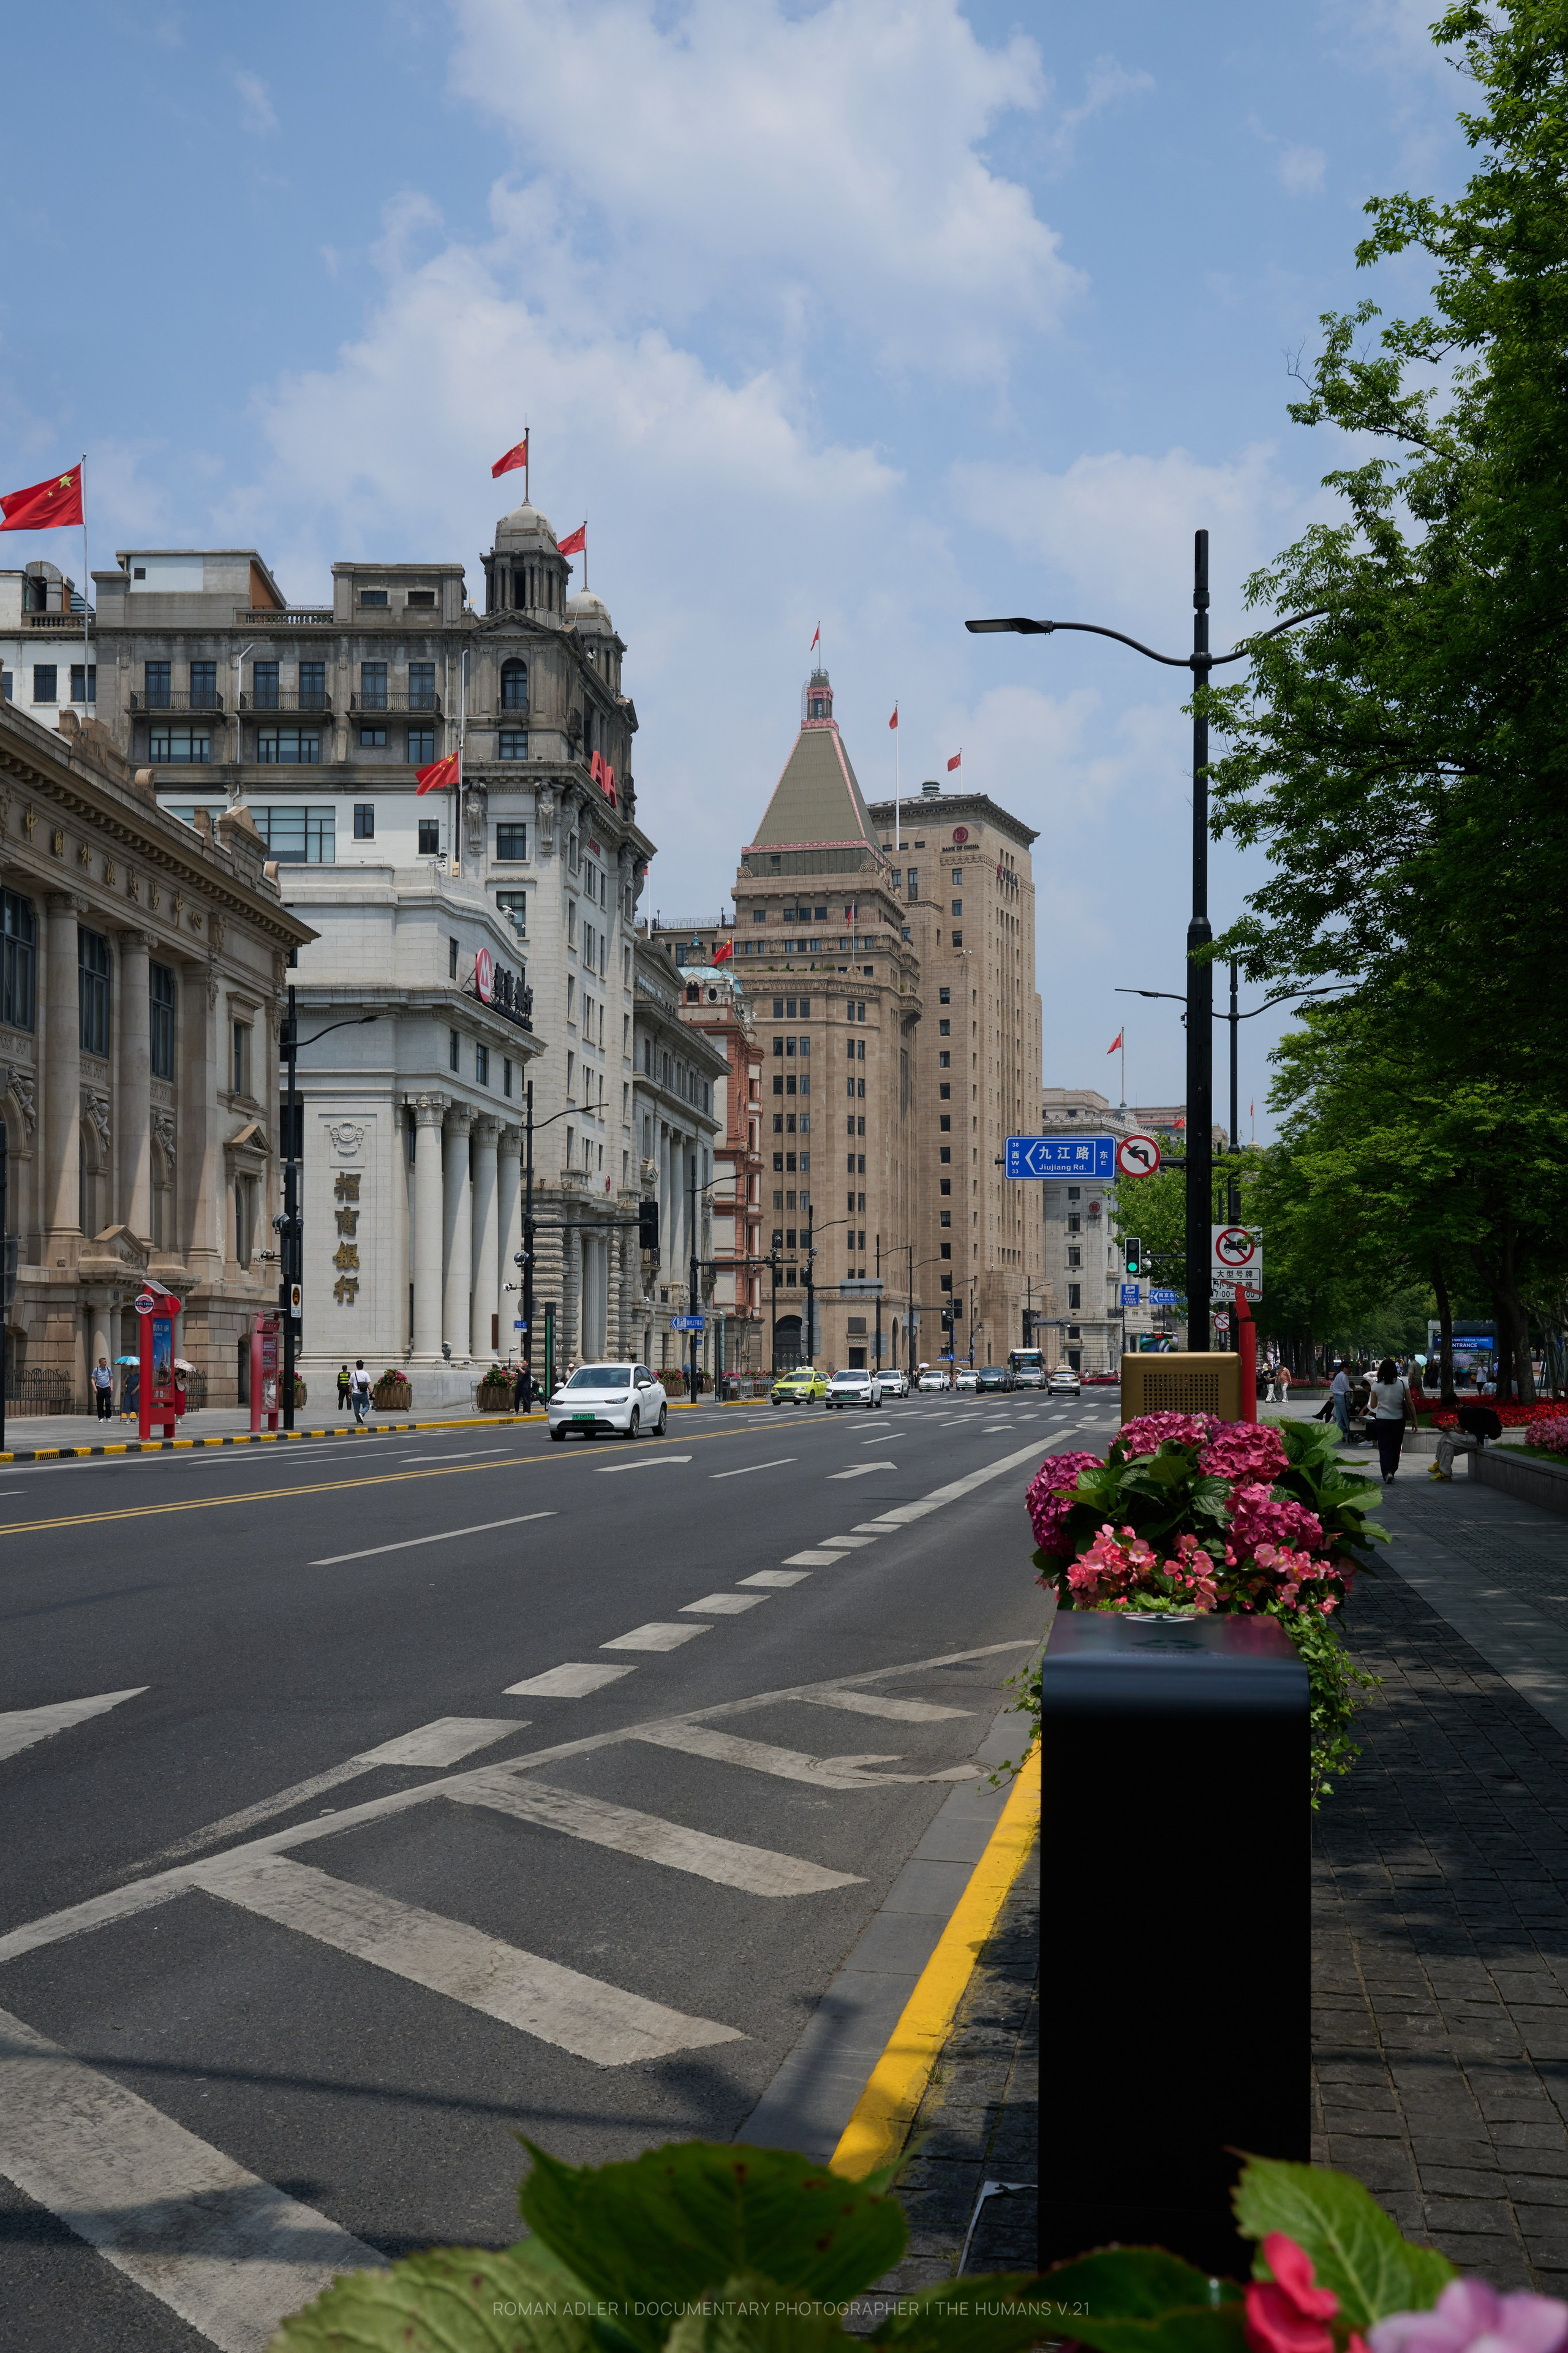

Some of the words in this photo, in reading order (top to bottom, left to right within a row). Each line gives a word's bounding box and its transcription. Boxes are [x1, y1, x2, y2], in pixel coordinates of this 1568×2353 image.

[590, 750, 617, 807] AIA
[1039, 1146, 1090, 1160] 九江路
